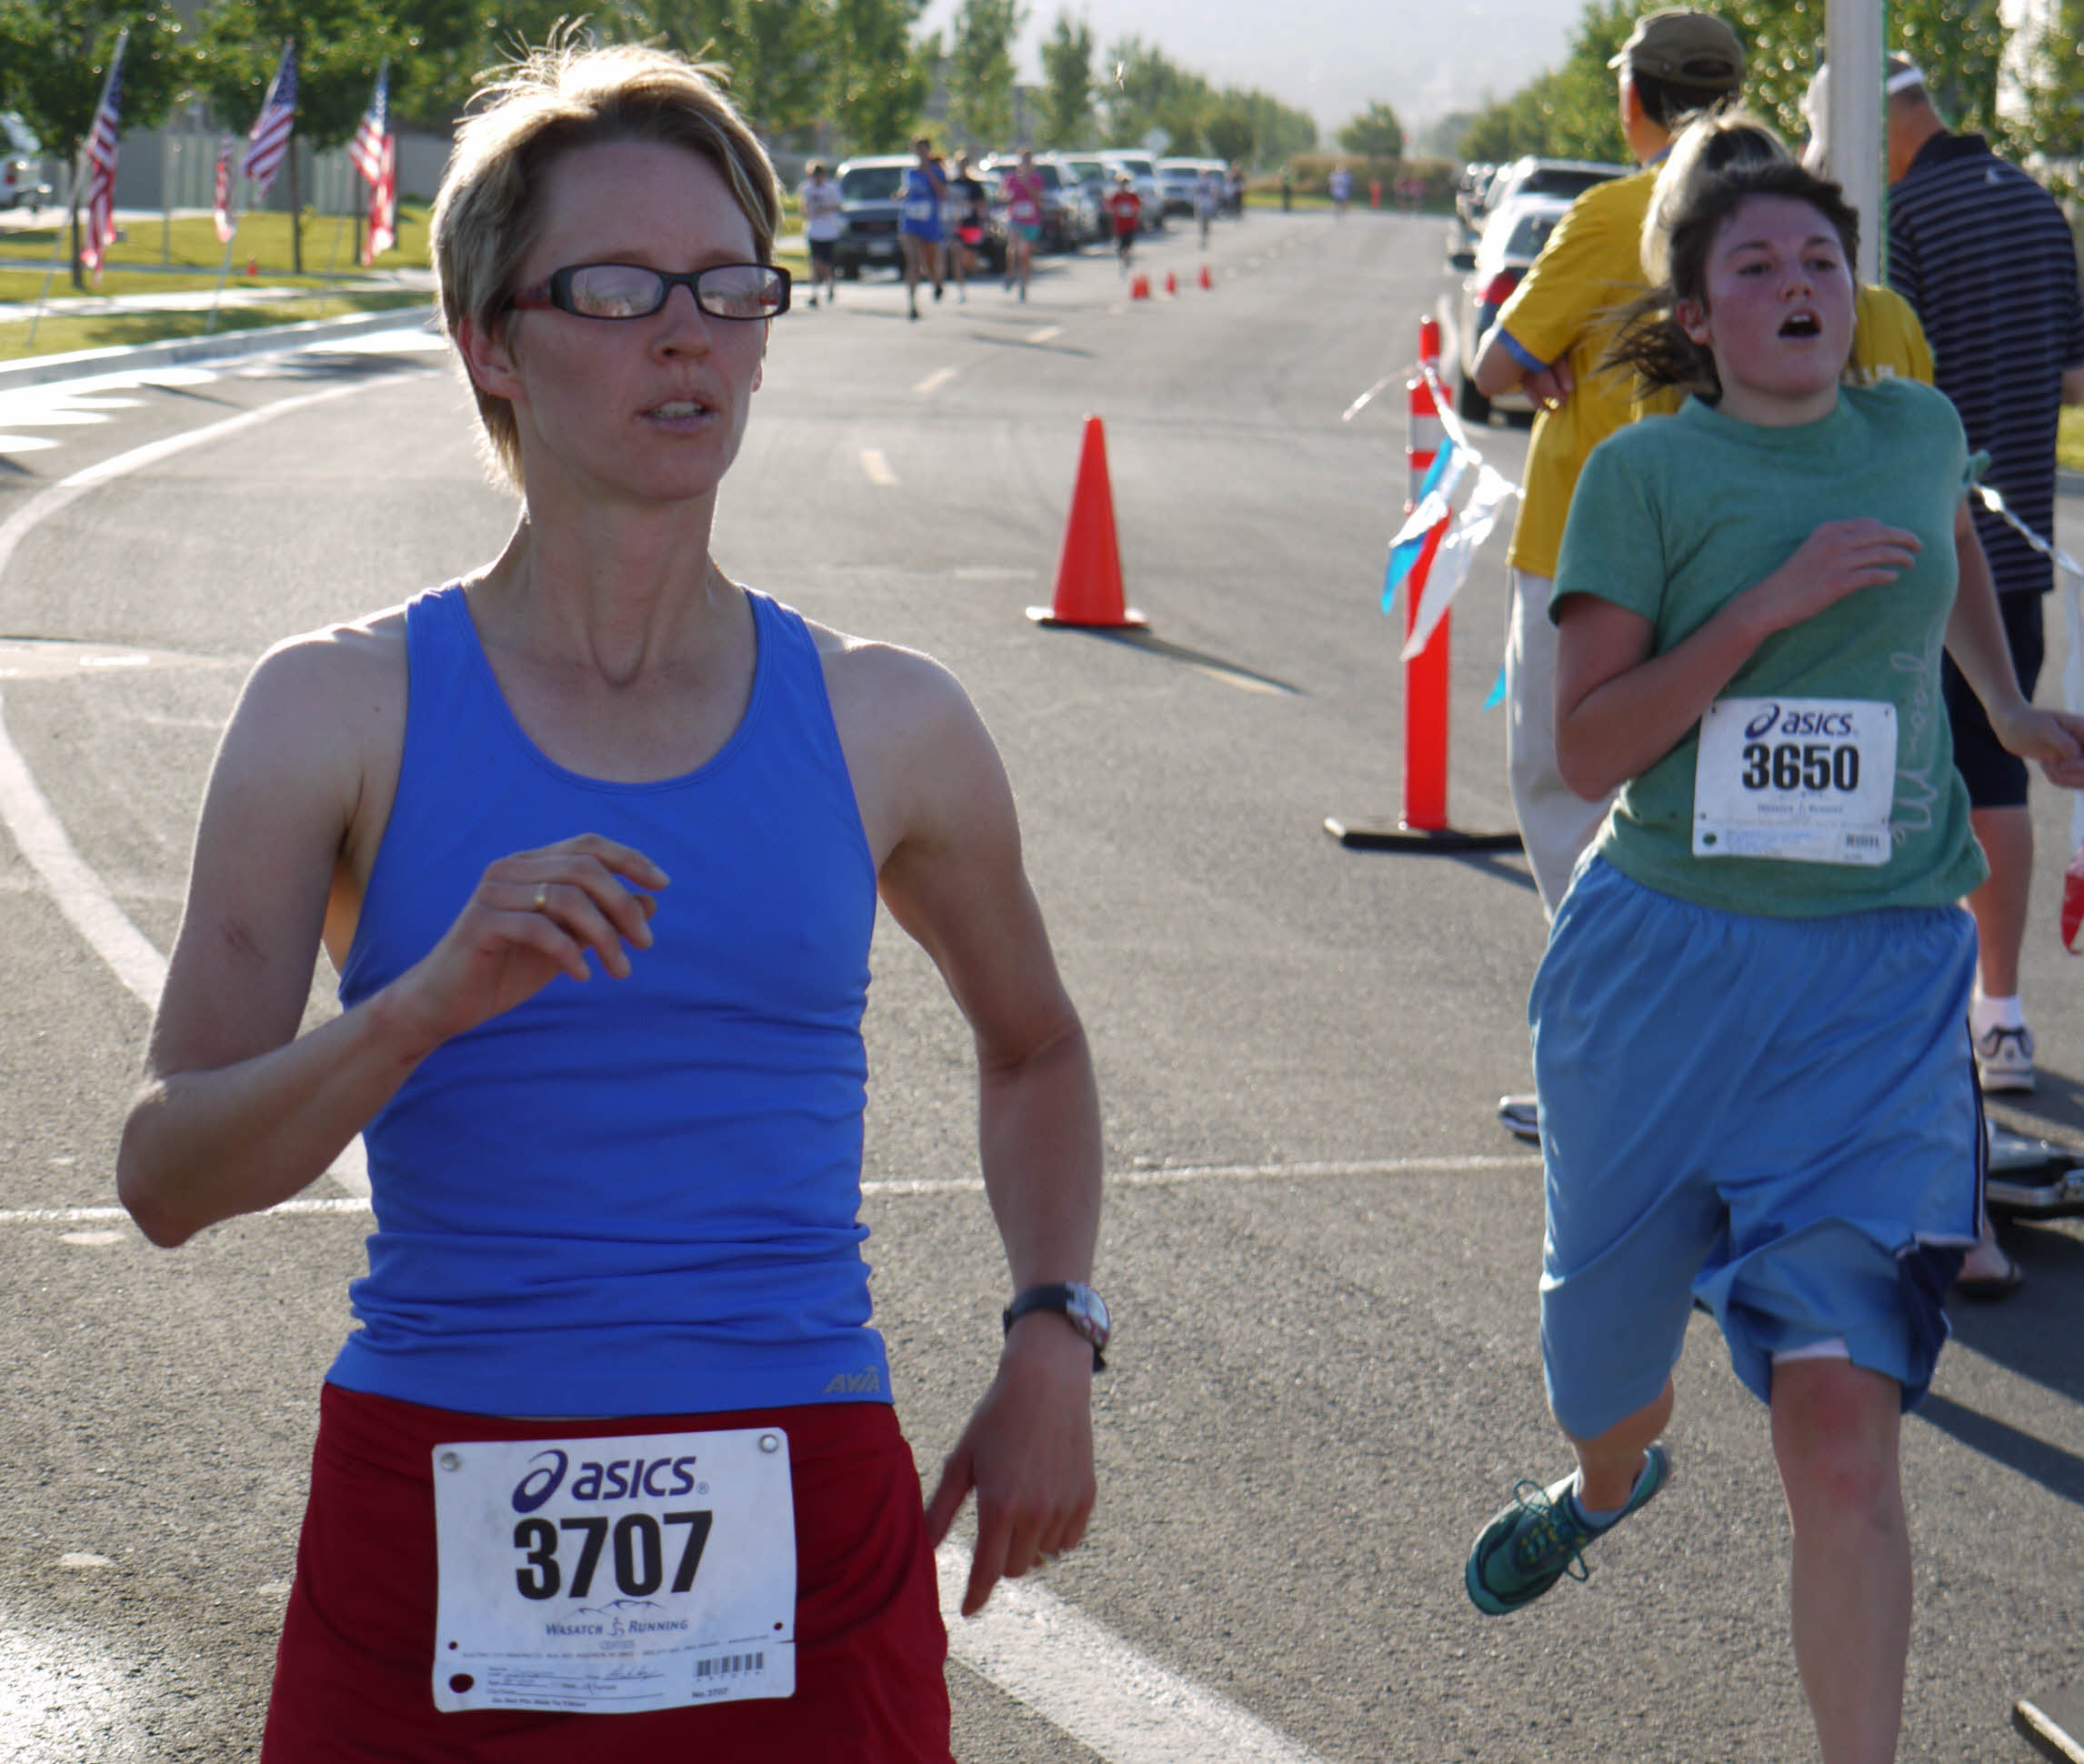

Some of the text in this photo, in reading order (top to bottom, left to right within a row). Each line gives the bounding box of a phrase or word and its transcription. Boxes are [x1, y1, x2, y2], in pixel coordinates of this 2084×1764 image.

[1780, 712, 1853, 737] asics
[1742, 742, 1859, 792] 3650
[571, 1456, 696, 1501] asics
[513, 1509, 713, 1600] 3707
[546, 1619, 689, 1636] WASATCH RUNNING
